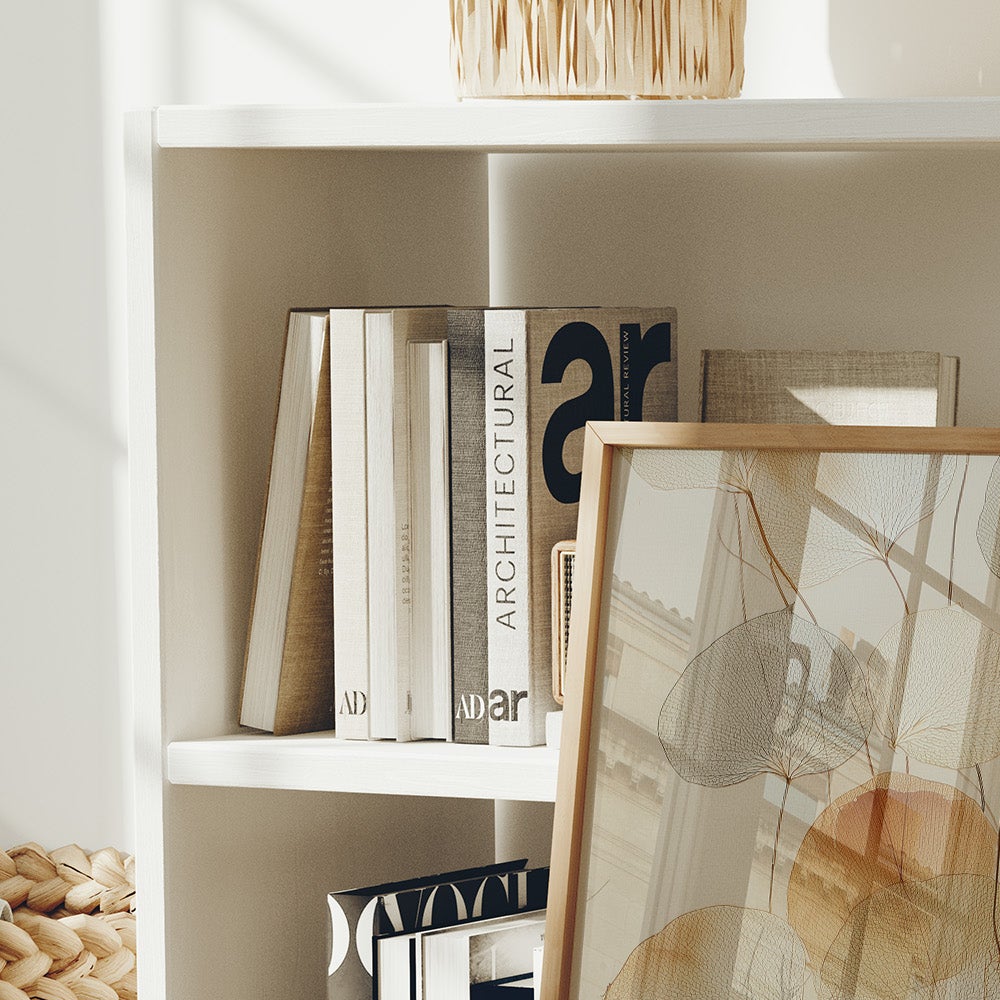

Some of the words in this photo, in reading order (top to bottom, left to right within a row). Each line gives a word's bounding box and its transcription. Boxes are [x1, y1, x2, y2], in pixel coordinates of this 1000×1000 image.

[622, 330, 630, 379] REVIEW
[541, 321, 671, 504] ar
[622, 384, 630, 422] URAL
[493, 338, 515, 630] ARCHITECTURAL
[339, 690, 367, 716] AD
[455, 694, 486, 721] AD
[489, 688, 528, 722] ar
